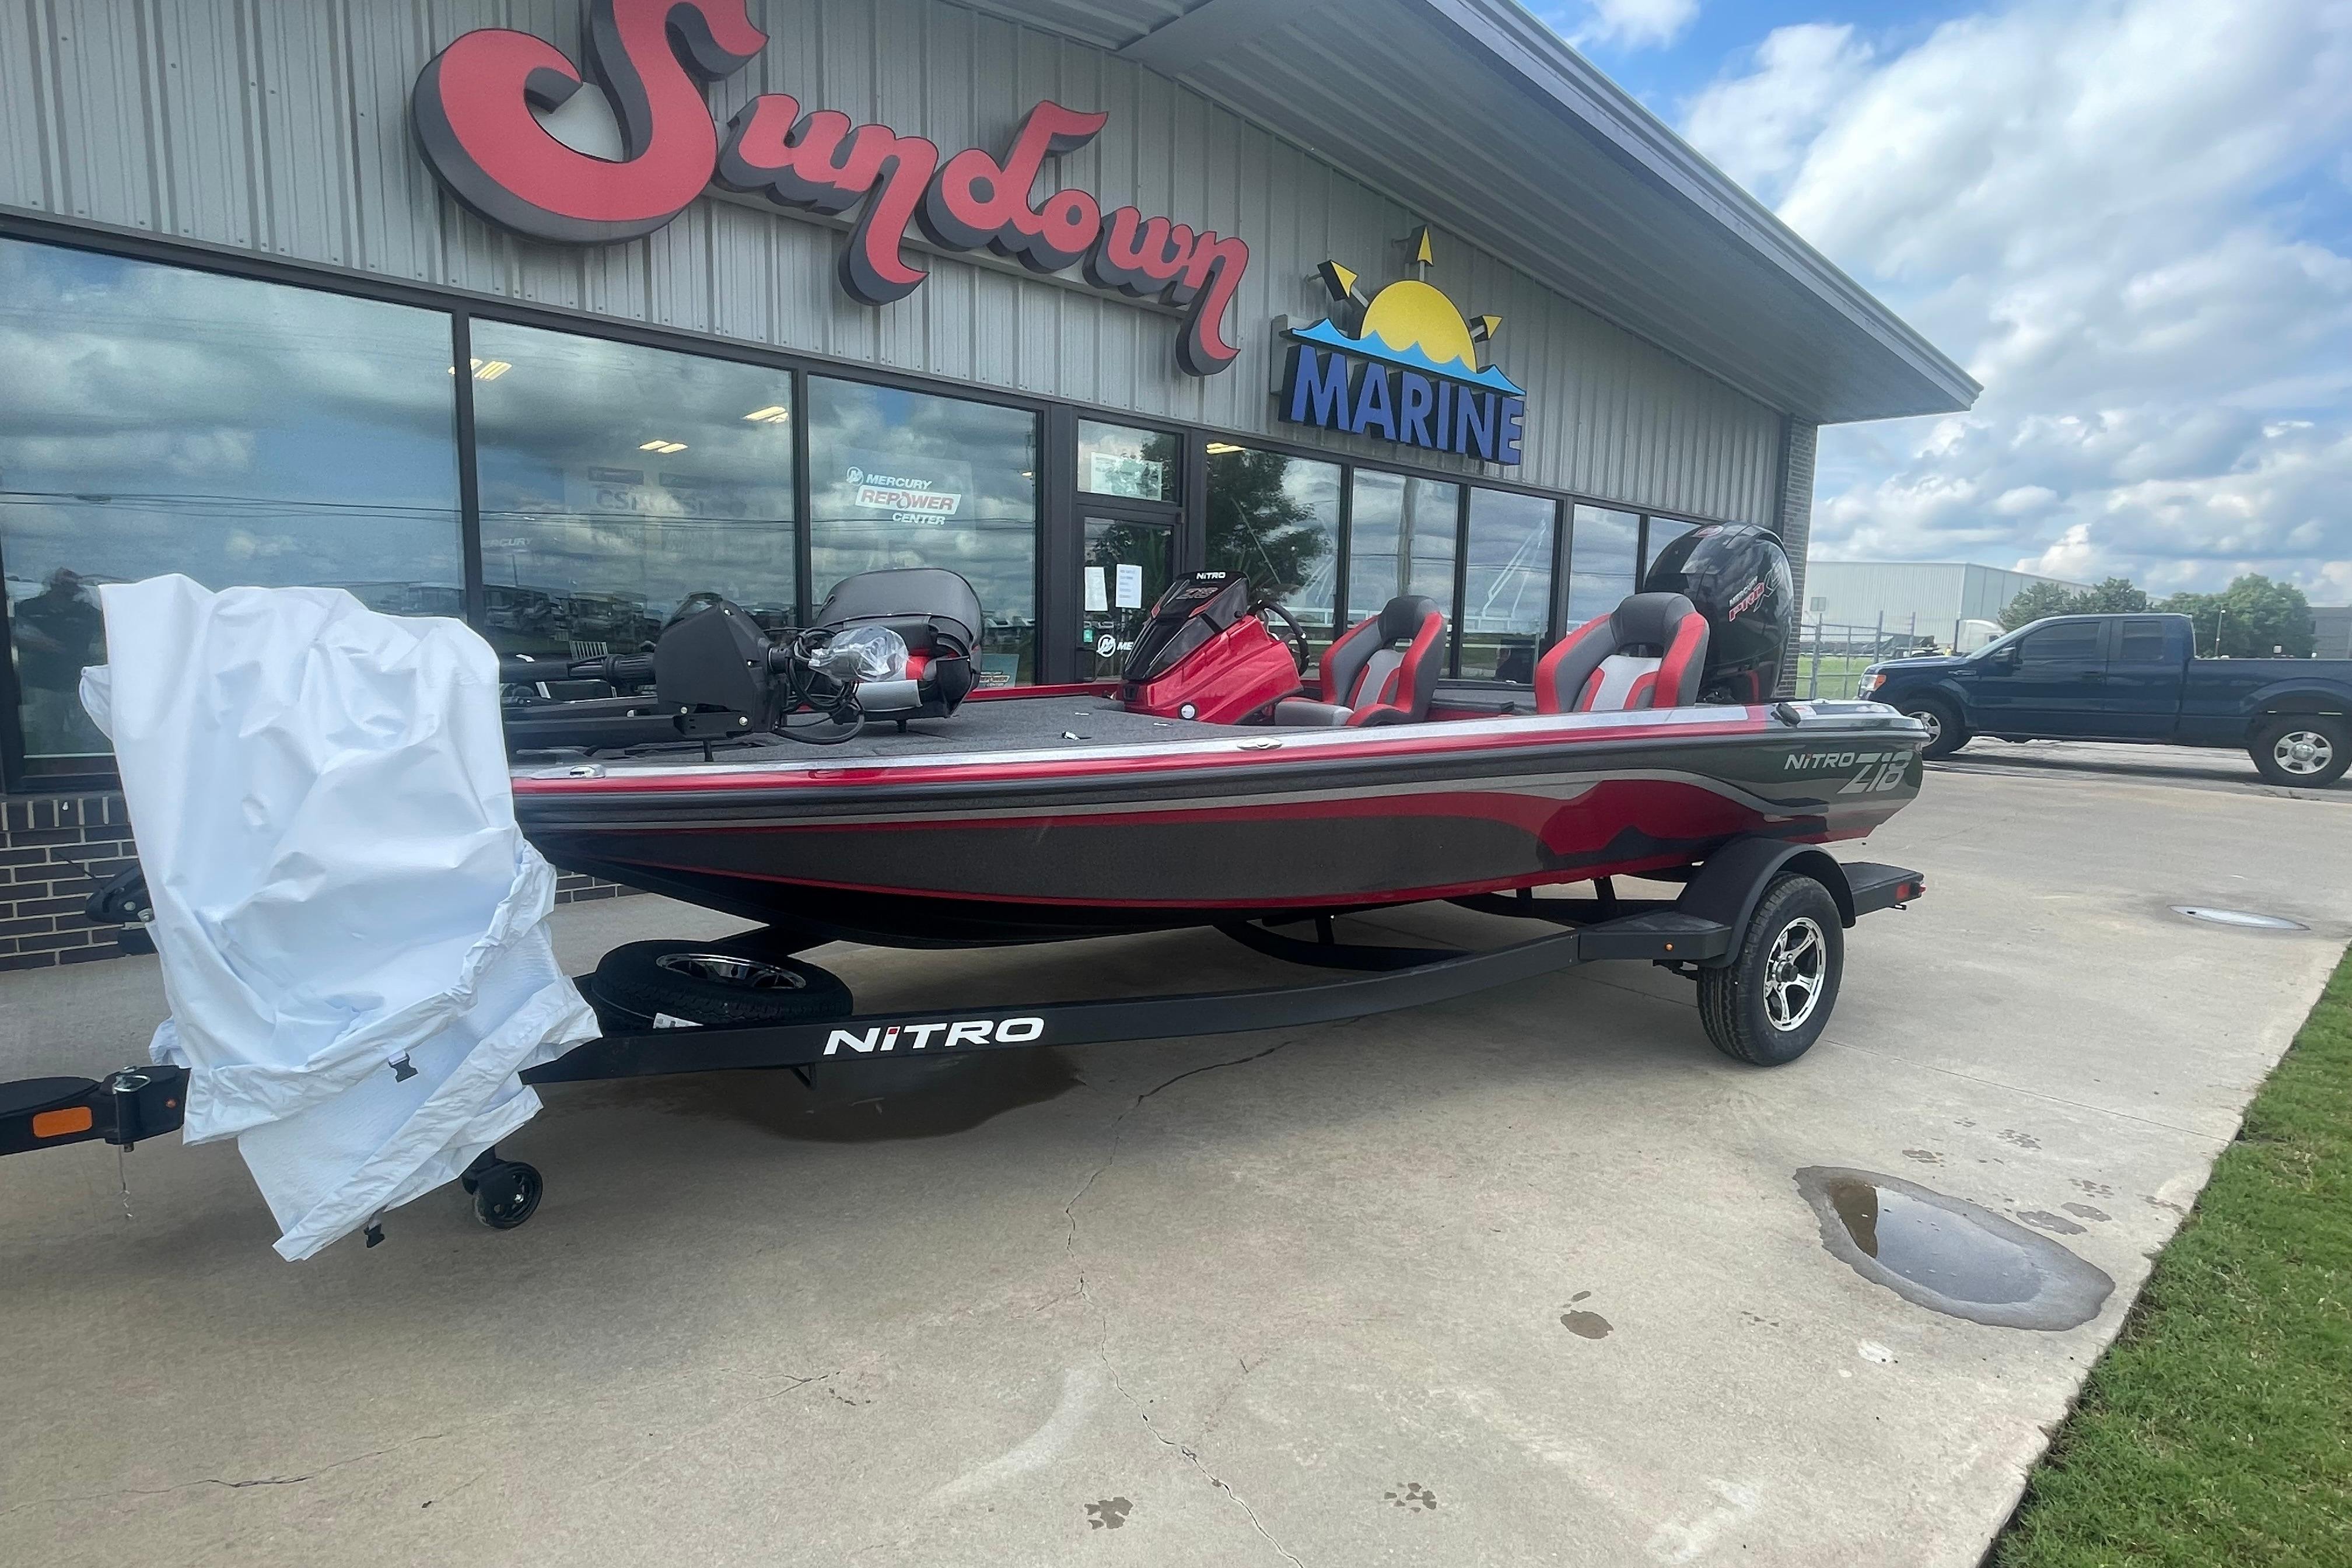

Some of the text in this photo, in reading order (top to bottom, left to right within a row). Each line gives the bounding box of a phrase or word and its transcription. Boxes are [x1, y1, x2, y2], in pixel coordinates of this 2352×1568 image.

[413, 0, 1250, 376] Sundown
[1287, 343, 1525, 466] MARINE
[866, 473, 932, 489] MERCURY
[860, 489, 955, 511] REPOWER
[892, 512, 946, 526] CENTER
[1836, 749, 1914, 794] Z18
